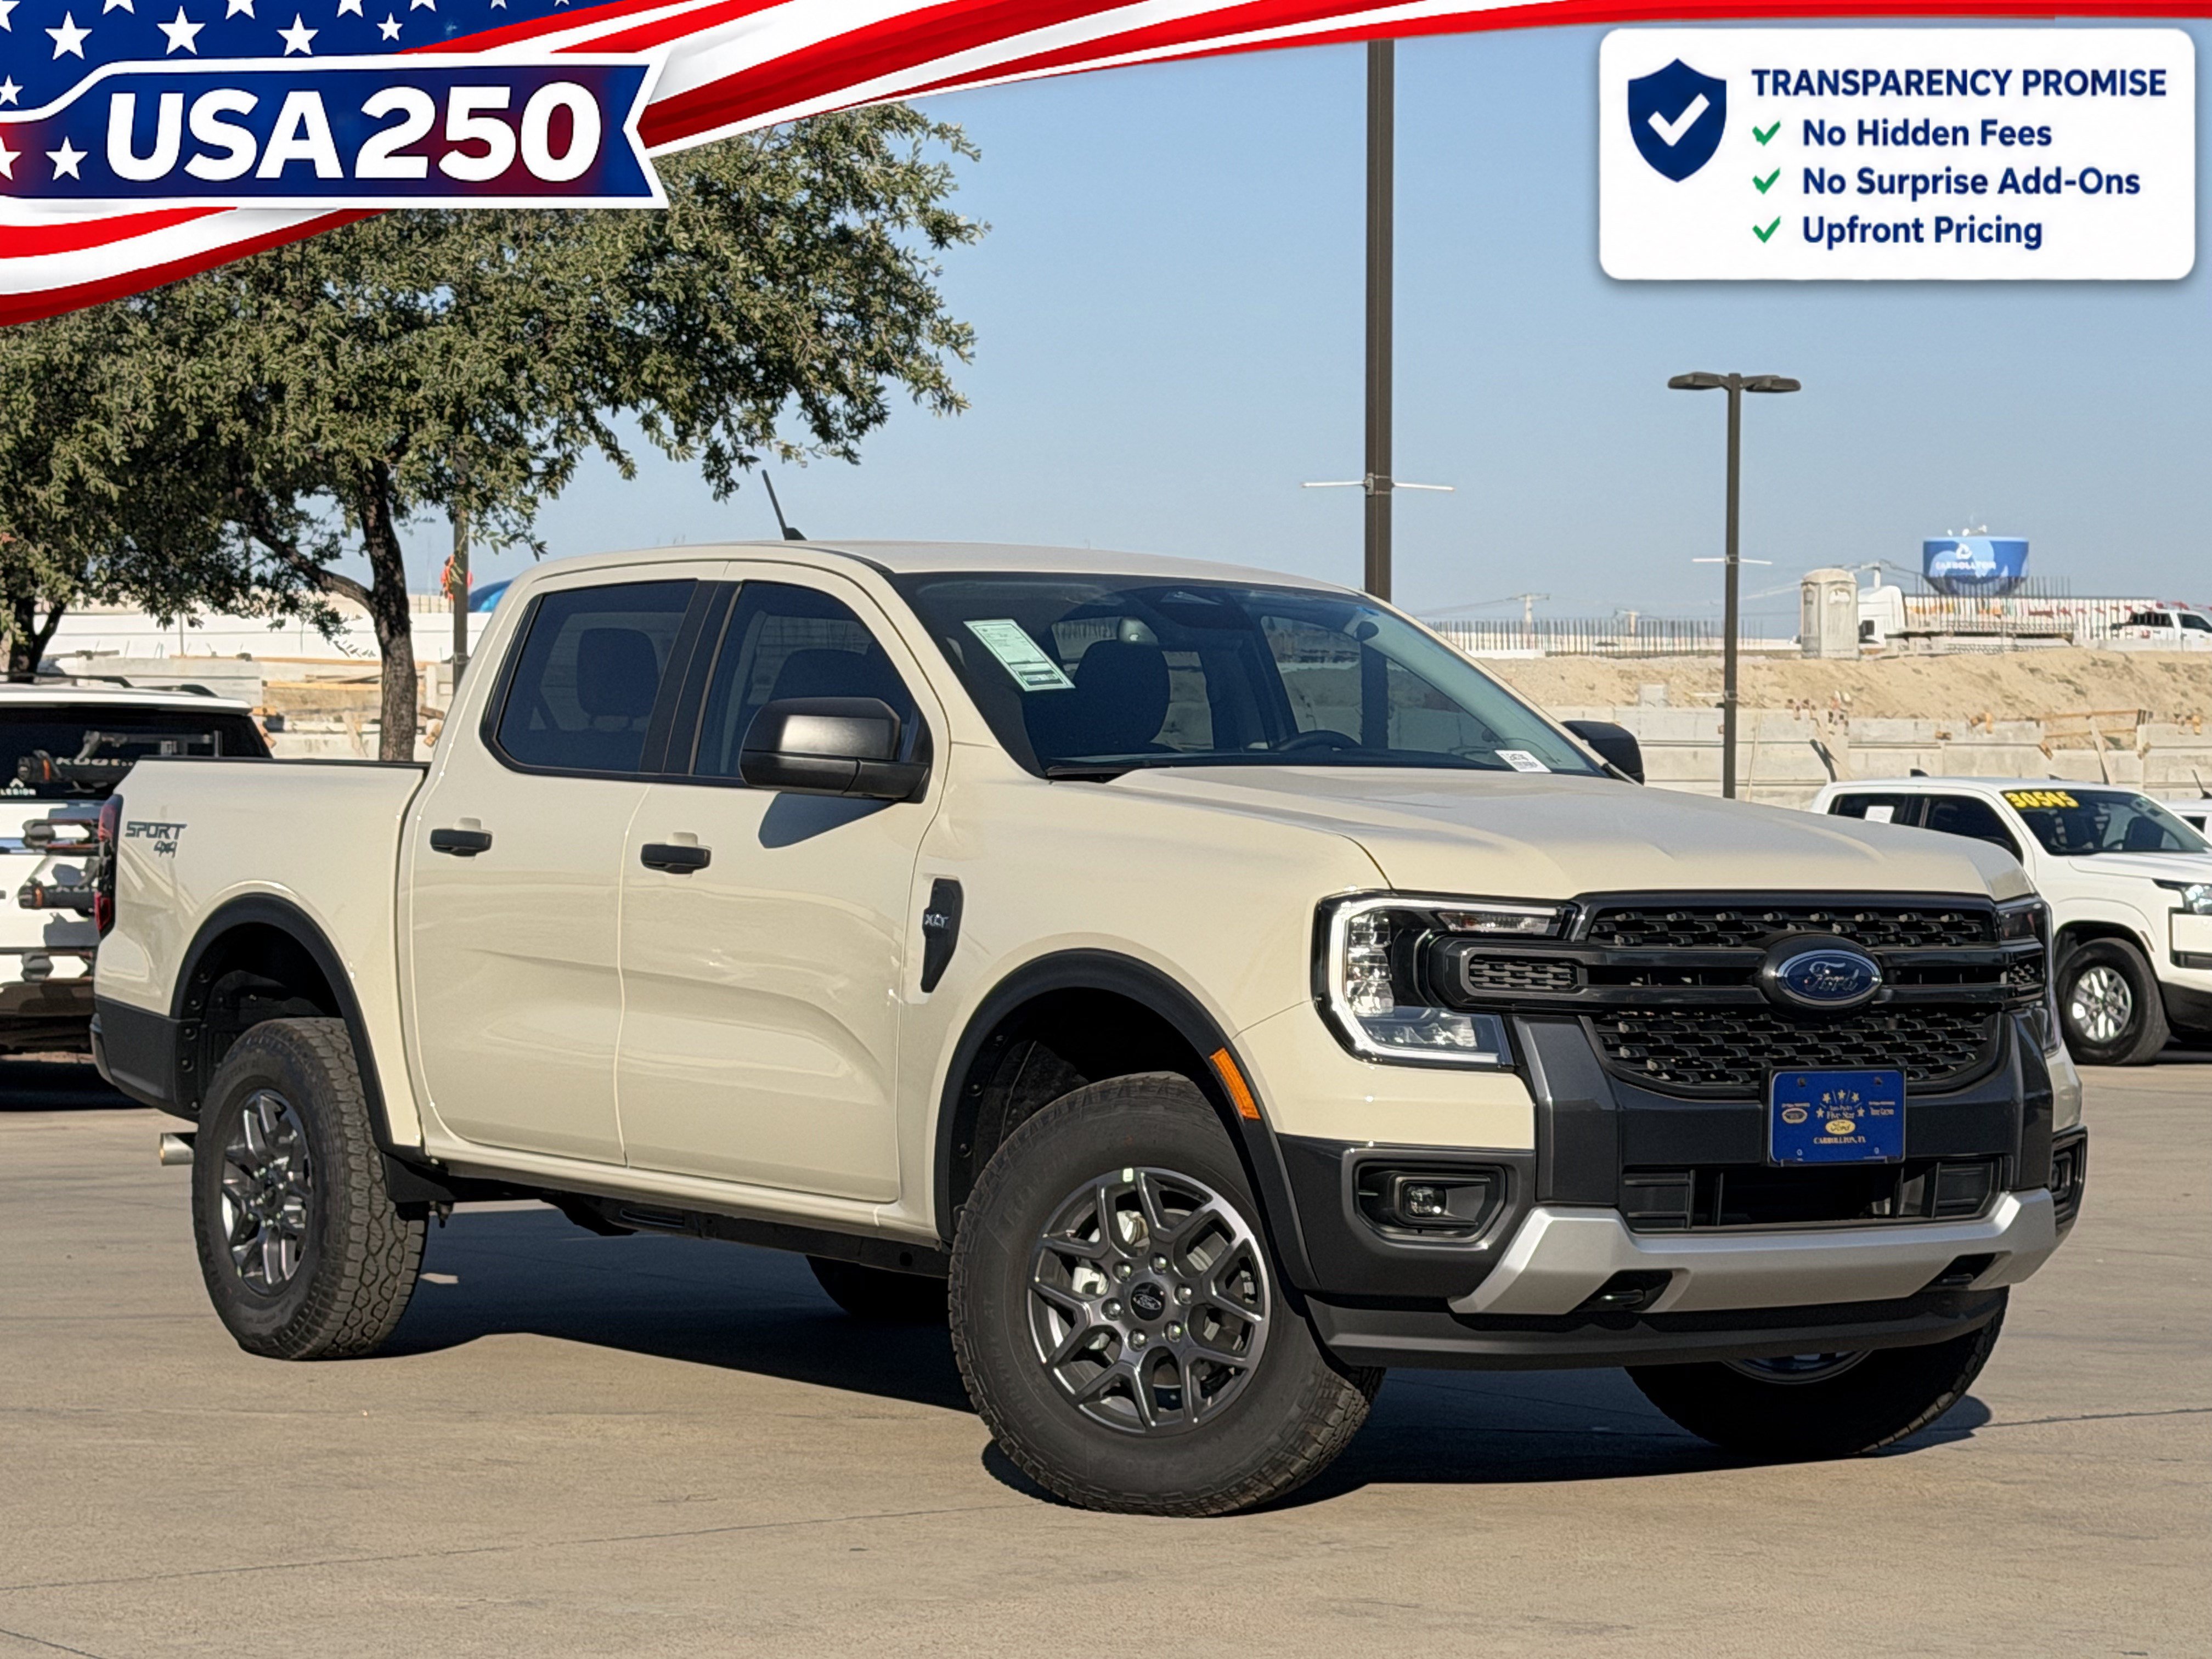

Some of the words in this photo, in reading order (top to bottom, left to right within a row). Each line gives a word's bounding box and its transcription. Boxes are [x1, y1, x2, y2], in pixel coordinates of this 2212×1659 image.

[2004, 791, 2080, 808] 30545
[125, 821, 188, 840] SPORT
[924, 913, 950, 928] XLT
[1804, 961, 1860, 991] Ford
